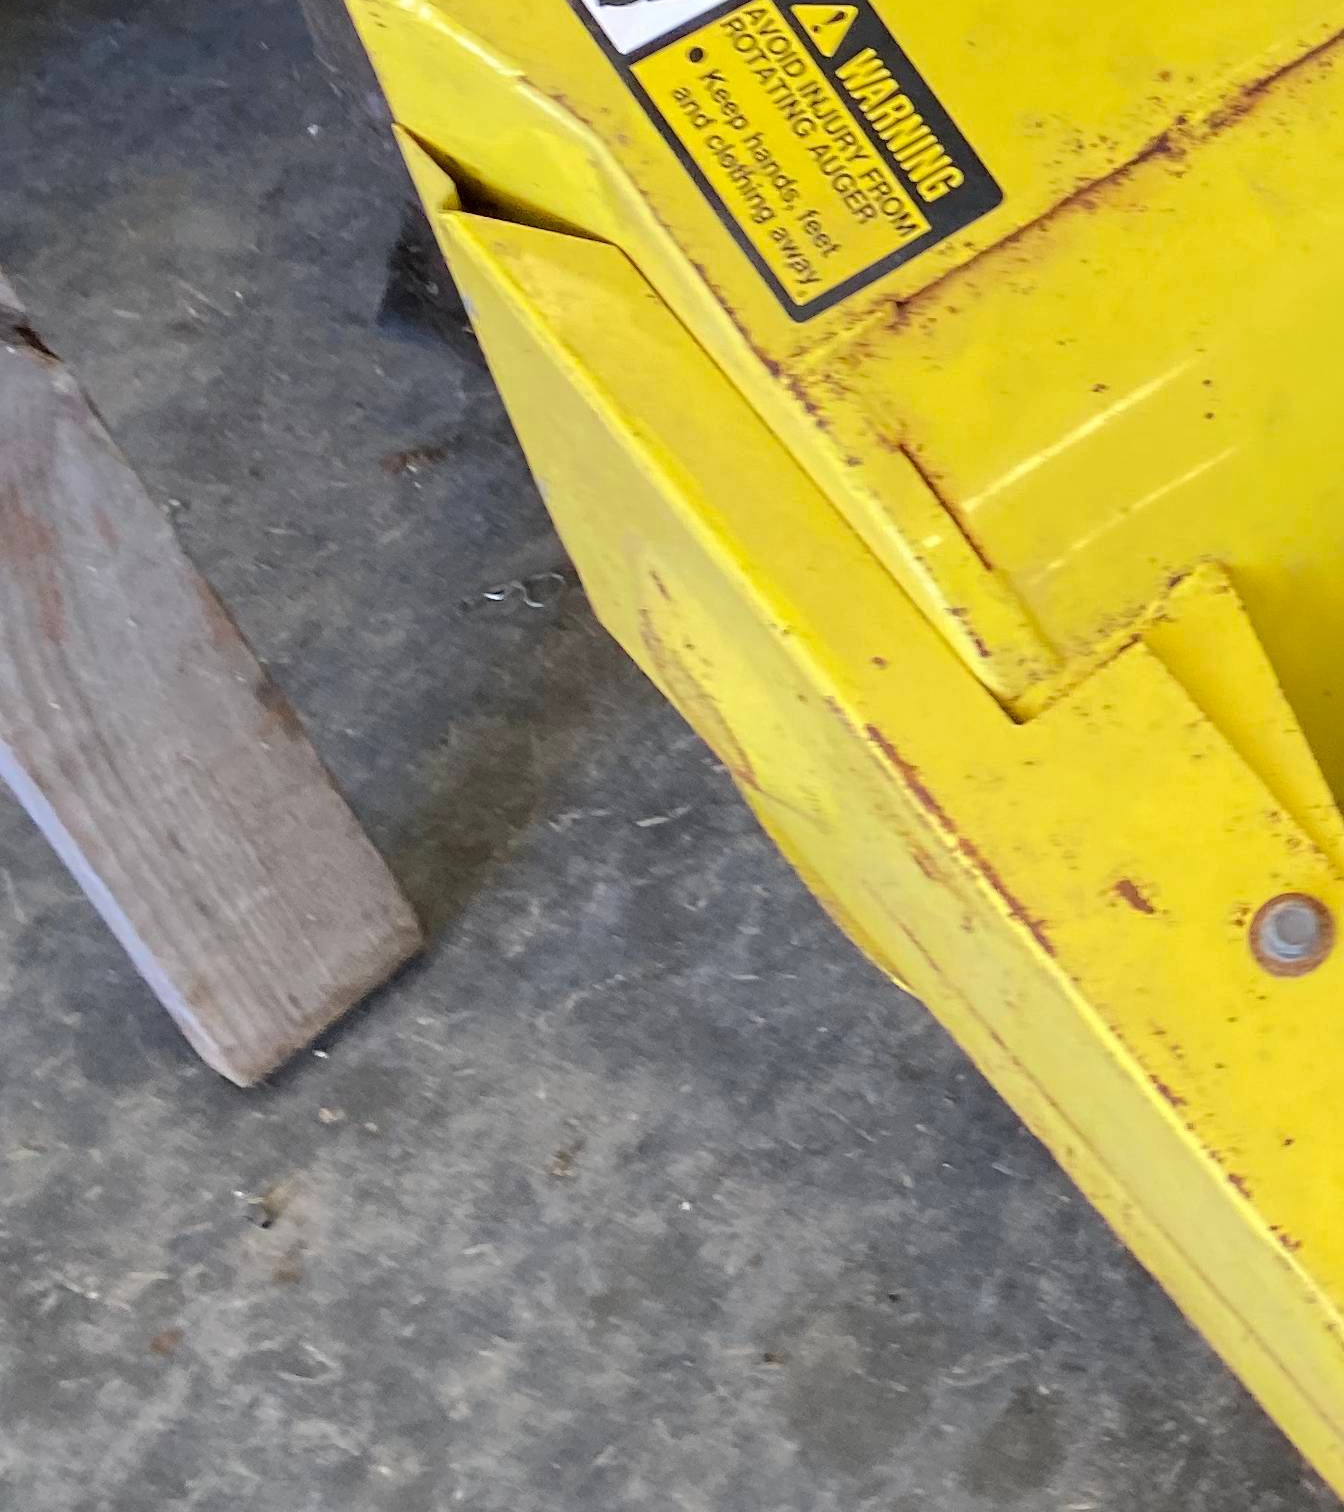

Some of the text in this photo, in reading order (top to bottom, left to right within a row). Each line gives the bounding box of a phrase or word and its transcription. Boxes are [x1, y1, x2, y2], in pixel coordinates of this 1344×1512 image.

[672, 87, 821, 284] and clothing away
[698, 69, 841, 257] Keep hands, feet
[720, 17, 877, 224] ROTATING AUGER
[743, 8, 920, 236] AVOID INJURY FROM
[835, 47, 965, 203] WARNING
